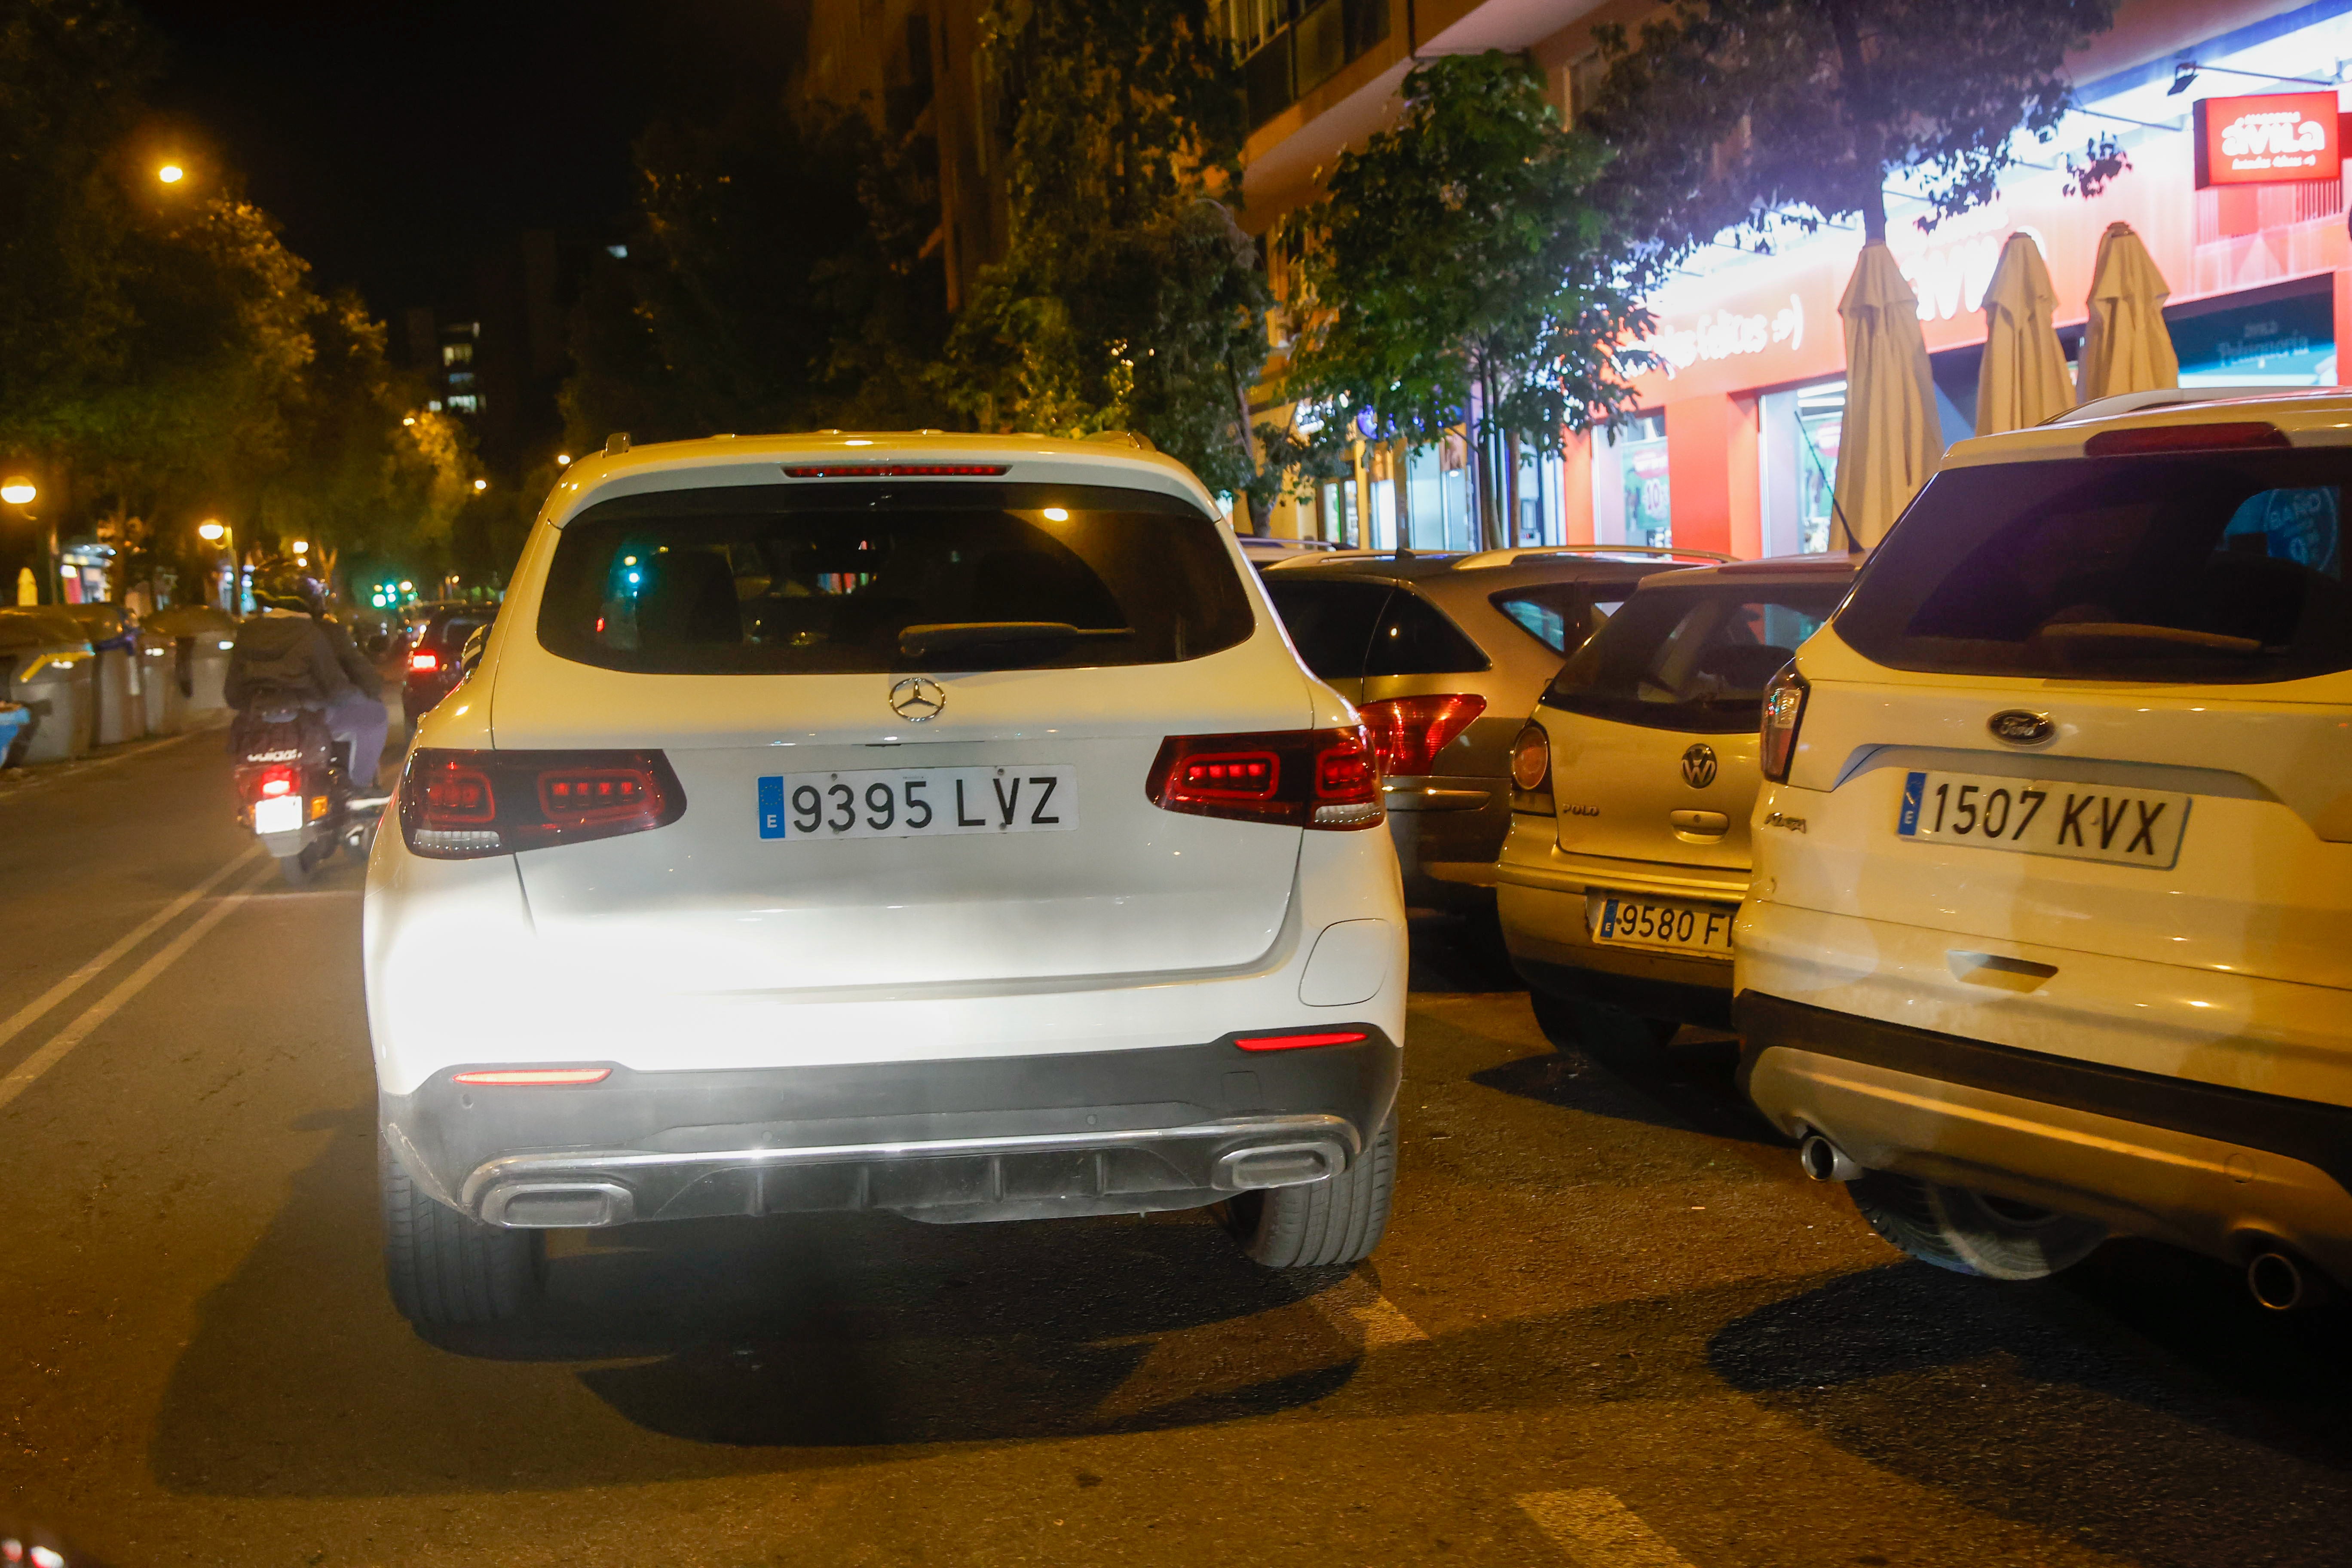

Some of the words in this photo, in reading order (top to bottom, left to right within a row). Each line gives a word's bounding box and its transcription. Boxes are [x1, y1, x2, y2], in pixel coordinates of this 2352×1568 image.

[2001, 716, 2039, 736] Ford
[767, 815, 777, 828] E
[792, 781, 932, 833] 9395
[956, 777, 1059, 827] LVZ
[1562, 802, 1601, 817] POLO
[1904, 810, 1914, 825] E
[1934, 783, 2047, 840] 1507
[2058, 794, 2166, 855] KVX
[1605, 922, 1611, 932] E
[1620, 904, 1695, 942] 9580
